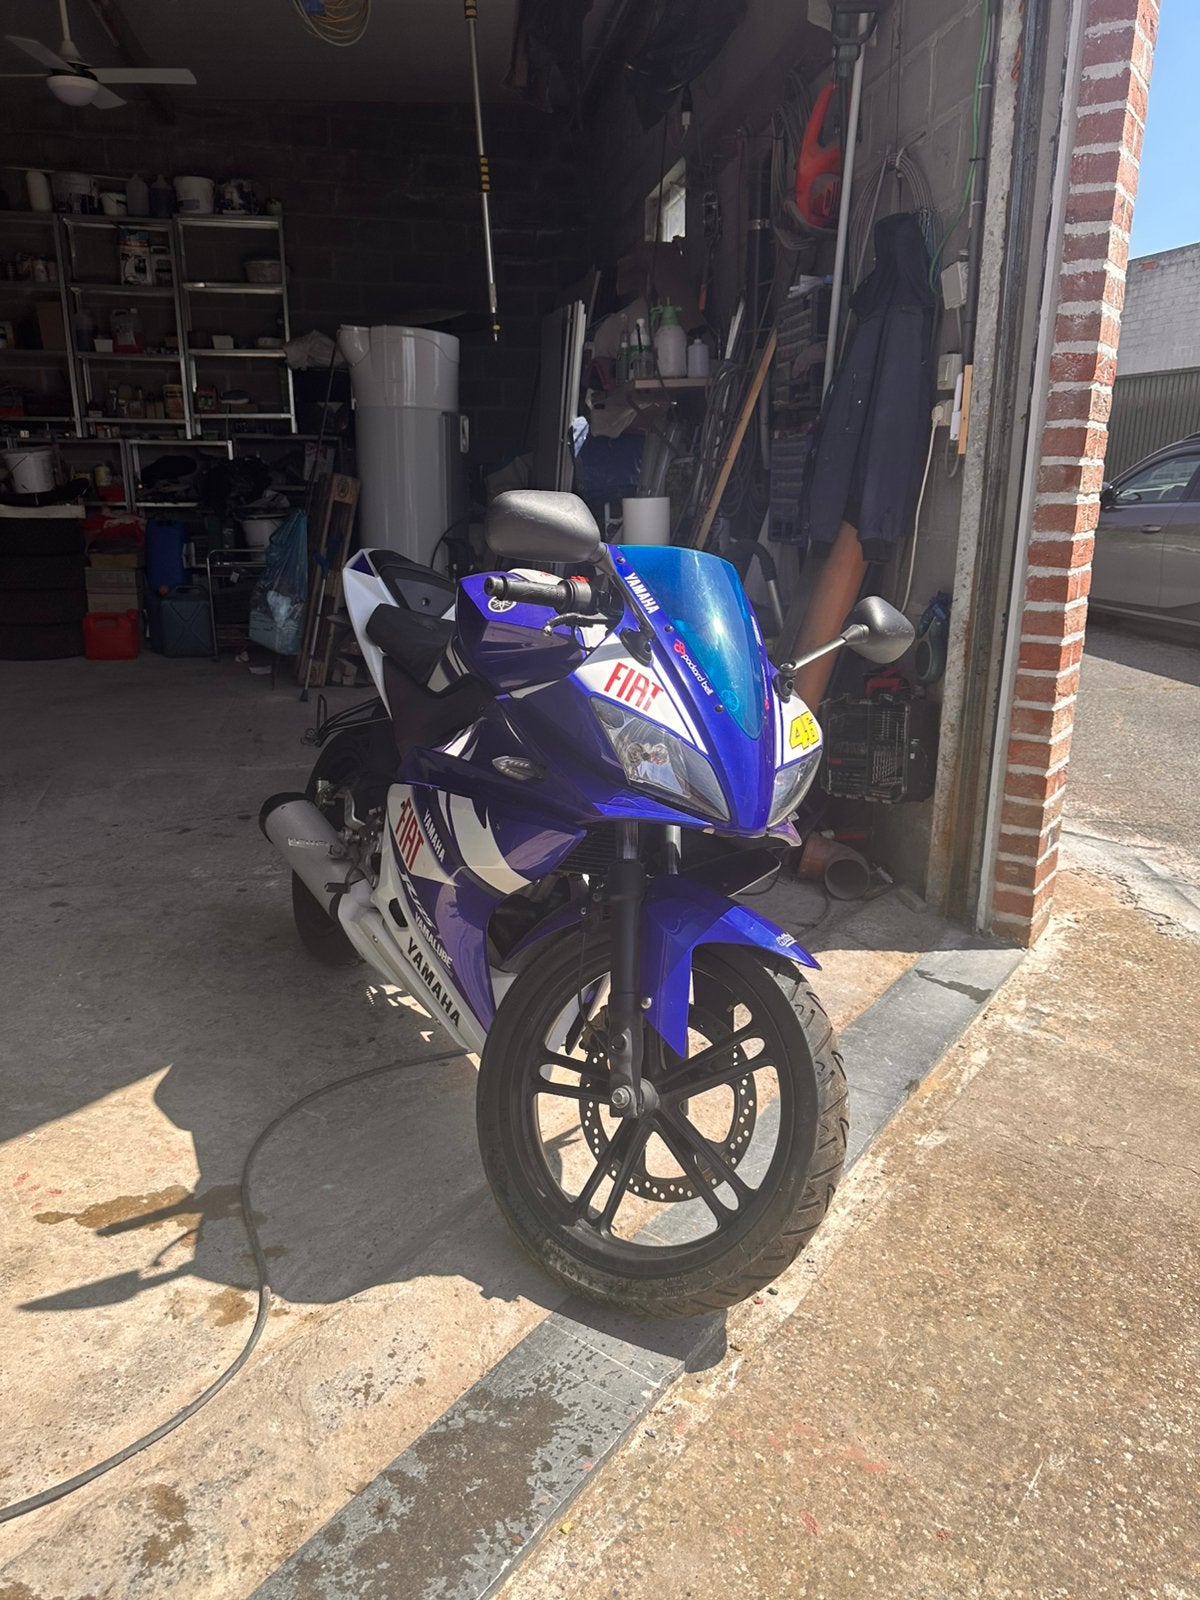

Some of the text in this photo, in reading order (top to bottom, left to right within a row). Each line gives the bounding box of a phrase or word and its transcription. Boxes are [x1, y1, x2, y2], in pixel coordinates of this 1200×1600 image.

[624, 572, 660, 614] YAMAHA
[603, 662, 664, 712] FIAT
[681, 655, 714, 696] packard bell
[789, 711, 819, 750] 46
[396, 797, 424, 871] FIAT
[423, 809, 446, 863] YAMAHA
[415, 911, 453, 969] YAMALUBE
[407, 936, 460, 1028] YAMAHA
